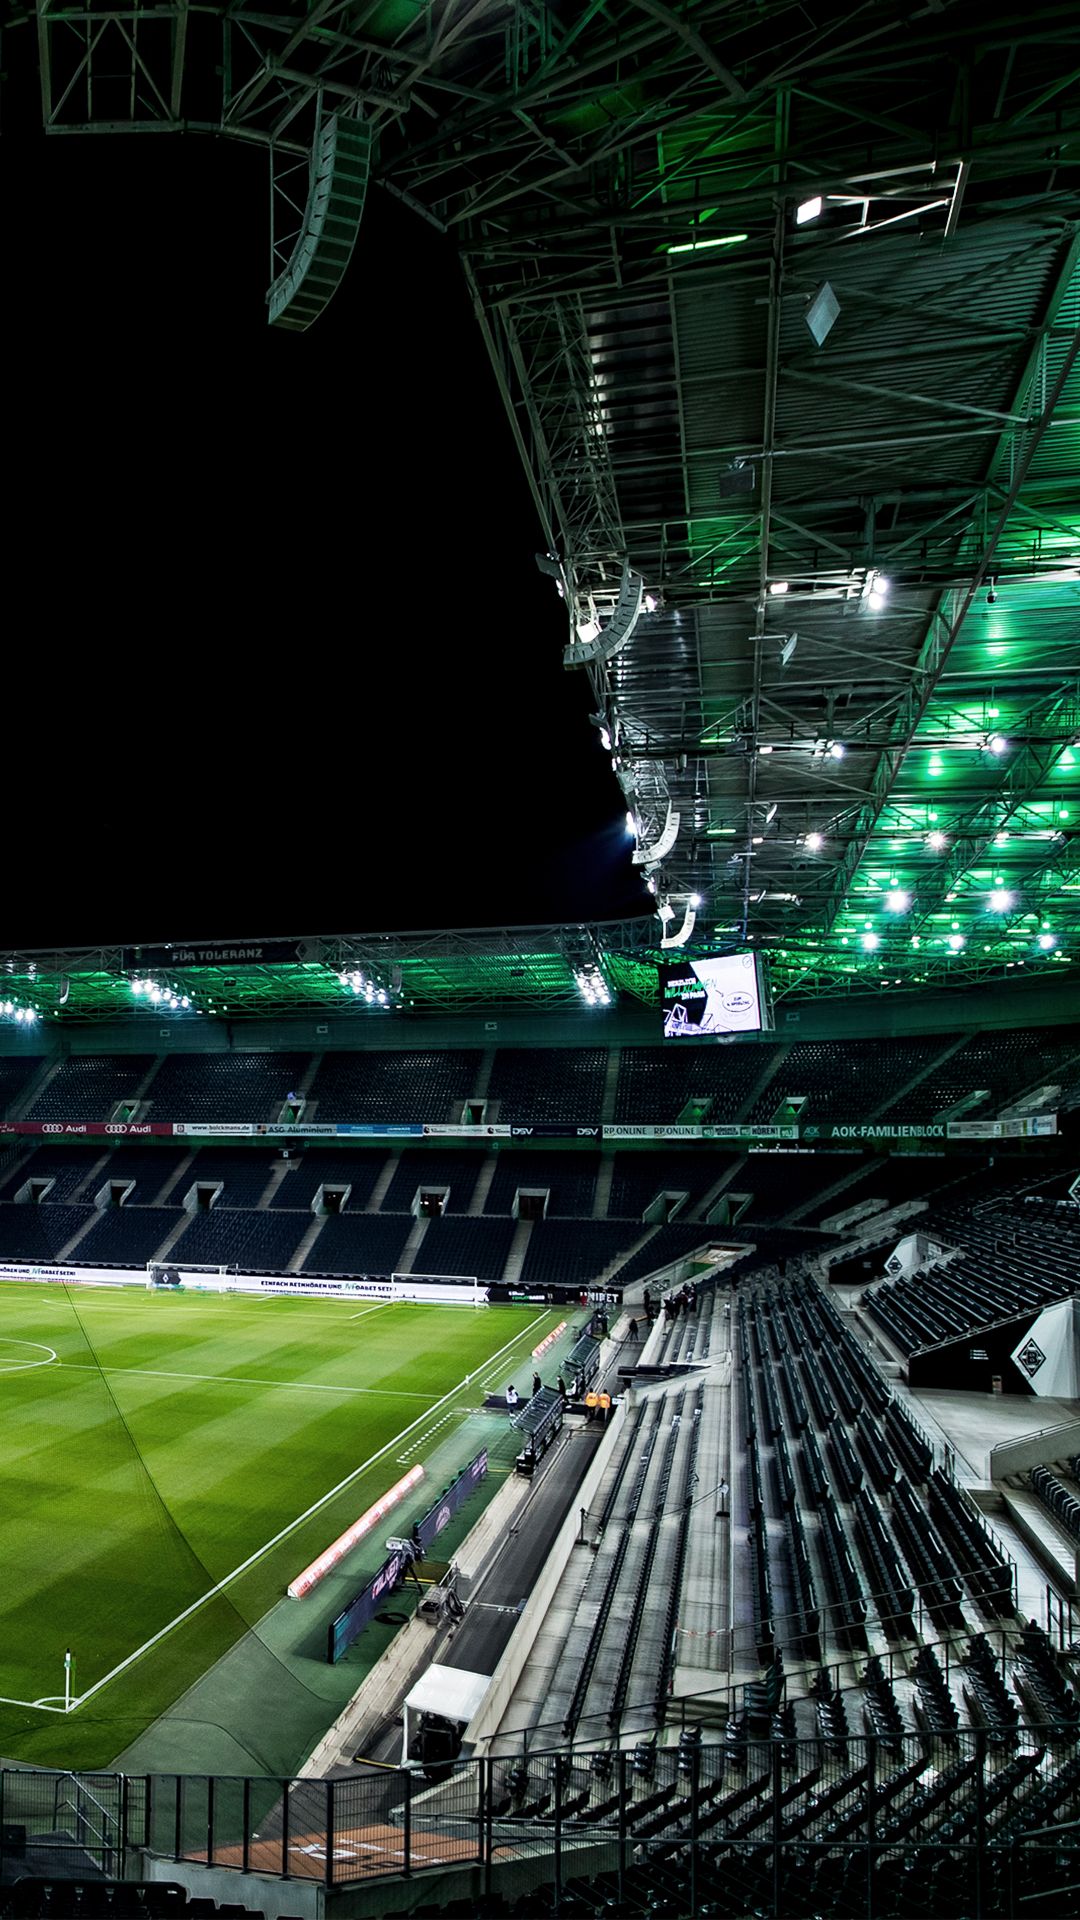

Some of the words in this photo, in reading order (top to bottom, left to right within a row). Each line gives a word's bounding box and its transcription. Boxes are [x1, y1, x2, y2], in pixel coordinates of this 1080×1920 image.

[172, 949, 196, 961] FÜR
[198, 948, 263, 960] TOLERANZ
[65, 1125, 87, 1133] Audi
[129, 1125, 151, 1133] Audi
[616, 1127, 647, 1135] ONLINE
[666, 1127, 695, 1135] ONLINE
[831, 1125, 944, 1137] AOK-FAMILIENBLOCK
